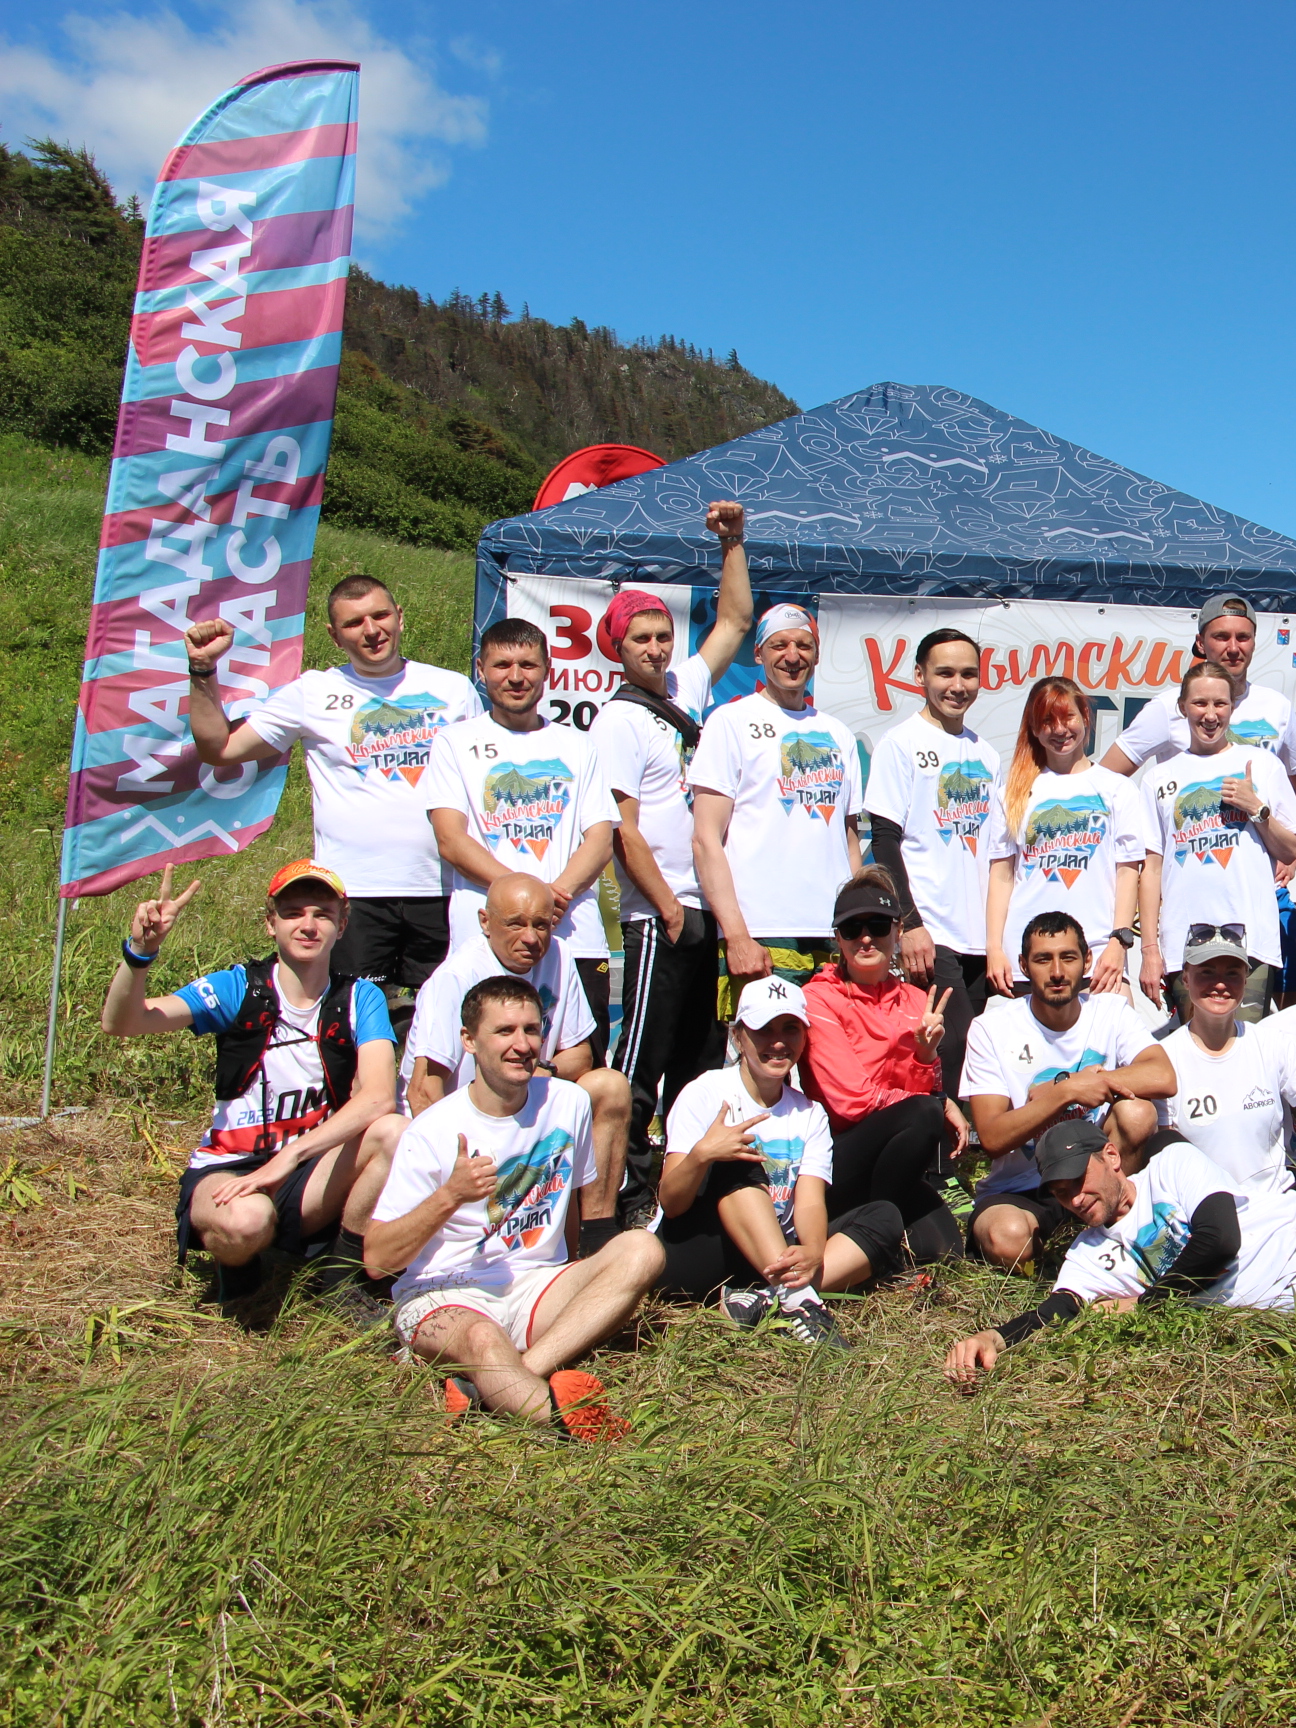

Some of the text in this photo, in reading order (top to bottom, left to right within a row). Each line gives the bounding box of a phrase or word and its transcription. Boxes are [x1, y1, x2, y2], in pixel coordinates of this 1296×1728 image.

[115, 181, 257, 793] МАГАДАНСКАЯ
[199, 436, 301, 799] ОЛАСТЬ
[549, 667, 625, 692] ИЮЛ
[325, 694, 354, 711] 28
[550, 699, 606, 732] 20
[749, 723, 776, 739] 38
[469, 743, 499, 759] 15
[916, 751, 940, 768] 39
[1157, 780, 1178, 800] 49
[502, 822, 553, 842] ТРИАЛ
[1188, 832, 1239, 853] ТРИАЛ
[1039, 853, 1088, 870] ТРИАЛ
[1187, 1094, 1218, 1118] 20
[1099, 1245, 1126, 1271] 37
